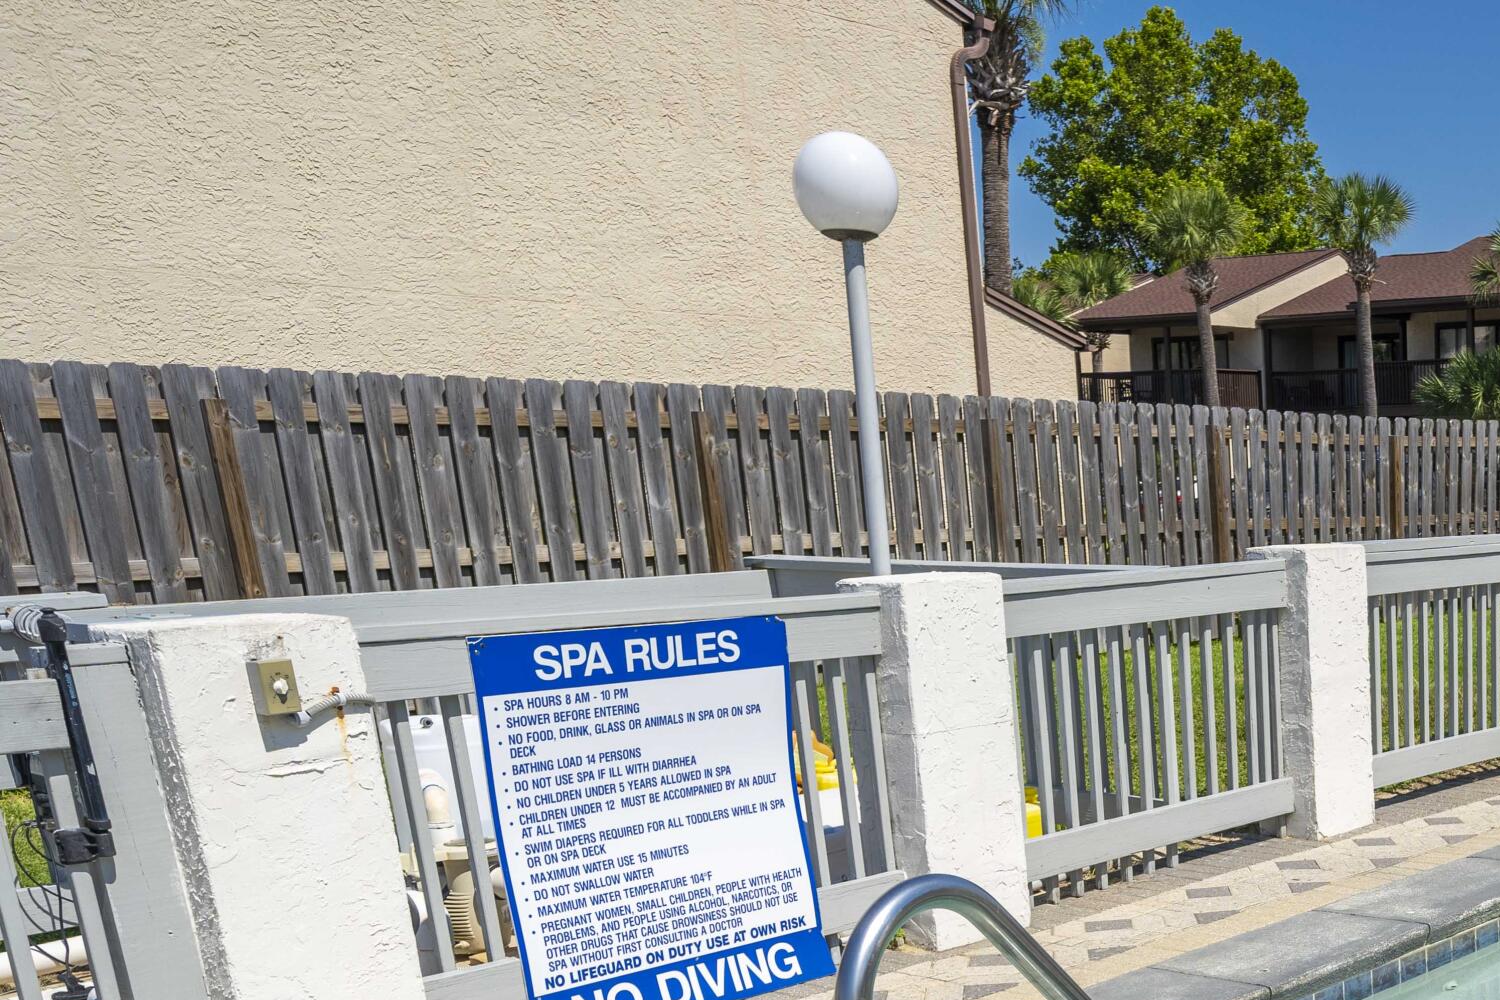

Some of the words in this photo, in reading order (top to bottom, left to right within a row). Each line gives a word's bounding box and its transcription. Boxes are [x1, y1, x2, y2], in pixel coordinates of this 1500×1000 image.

[533, 641, 613, 681] SPA
[624, 629, 741, 673] RULES
[503, 698, 525, 712] SPA
[526, 694, 563, 710] HOURS
[564, 693, 572, 706] 8
[574, 691, 591, 705] AM
[599, 689, 611, 702] 10
[613, 687, 629, 700] PM
[505, 712, 551, 729] SHOWER
[552, 708, 592, 724] BEFORE
[593, 702, 641, 719] ENTERING
[507, 732, 524, 746] NO
[525, 729, 557, 744] FOOD,
[558, 724, 592, 740] DRINK,
[594, 720, 626, 735] GLASS
[628, 718, 642, 731] OR
[644, 712, 685, 729] ANIMALS
[686, 711, 696, 723] IN
[697, 709, 715, 722] SPA
[716, 707, 730, 719] OR
[730, 705, 744, 717] ON
[745, 703, 762, 716] SPA
[509, 744, 537, 760] DECK
[511, 759, 555, 776] BATHING
[556, 755, 583, 770] LOAD
[584, 753, 597, 766] 14
[598, 746, 642, 764] PERSONS
[513, 779, 529, 793] DO
[531, 776, 552, 791] NOT
[554, 773, 575, 787] USE
[576, 770, 596, 784] SPA
[597, 768, 606, 781] IF
[608, 766, 624, 779] ILL
[624, 761, 650, 776] WITH
[651, 754, 697, 772] DIARRHEA
[515, 796, 532, 810] NO
[533, 788, 583, 807] CHILDREN
[584, 783, 617, 799] UNDER
[618, 781, 626, 793] 5
[626, 776, 658, 791] YEARS
[660, 769, 702, 786] ALLOWED
[703, 767, 714, 779] IN
[714, 764, 732, 778] SPA
[518, 807, 568, 826] CHILDREN
[569, 801, 603, 817] UNDER
[604, 799, 616, 811] 12
[620, 793, 647, 809] MUST
[648, 791, 661, 804] BE
[662, 781, 723, 802] ACCOMPANIED
[724, 779, 736, 791] BY
[738, 777, 750, 789] AN
[752, 772, 777, 787] ADULT
[521, 826, 533, 840] AT
[536, 823, 556, 837] ALL
[556, 817, 587, 833] TIMES
[523, 839, 554, 856] SWIM
[554, 832, 597, 850] DIAPERS
[598, 823, 645, 842] REQUIRED
[646, 819, 666, 833] FOR
[667, 816, 685, 830] ALL
[684, 808, 730, 826] TODDLERS
[730, 802, 758, 818] WHILE
[758, 801, 769, 812] IN
[769, 798, 786, 811] SPA
[526, 855, 542, 869] OR
[543, 852, 559, 866] ON
[560, 848, 580, 862] SPA
[581, 843, 607, 859] DECK
[529, 864, 581, 886] MAXIMUM
[582, 858, 616, 875] WATER
[616, 854, 636, 868] USE
[637, 852, 648, 864] 15
[649, 843, 690, 862] MINUTES
[533, 888, 549, 902] DO
[550, 883, 571, 898] NOT
[573, 873, 621, 894] SWALLOW
[622, 866, 655, 883] WATER
[536, 897, 588, 918] MAXIMUM
[588, 890, 622, 907] WATER
[622, 875, 689, 899] TEMPERATURE
[540, 912, 593, 934] PREGNANT
[594, 904, 635, 922] WOMEN,
[635, 896, 668, 913] SMALL
[668, 886, 714, 906] CHILDREN,
[715, 878, 748, 895] PEOPLE
[747, 874, 771, 888] WITH
[771, 867, 803, 883] HEALTH
[543, 924, 599, 947] PROBLEMS,
[601, 919, 621, 934] AND
[622, 911, 658, 929] PEOPLE
[658, 904, 687, 921] USING
[688, 896, 730, 914] ALCOHOL,
[731, 884, 780, 904] NARCOTICS,
[780, 881, 793, 893] OR
[545, 942, 579, 960] OTHER
[580, 934, 614, 952] DRUGS
[614, 928, 639, 944] THAT
[640, 921, 670, 938] CAUSE
[671, 907, 728, 931] DROWSINESS
[729, 900, 763, 917] SHOULD
[764, 895, 781, 909] NOT
[782, 891, 799, 905] USE
[544, 974, 566, 991] NO
[569, 955, 643, 984] LIFEGUARD
[645, 949, 665, 965] ON
[667, 940, 702, 960] DUTY
[705, 934, 731, 950] USE
[733, 929, 747, 944] AT
[749, 922, 778, 939] OWN
[779, 915, 807, 932] RISK
[548, 958, 568, 973] SPA
[569, 946, 614, 968] WITHOUT
[616, 940, 643, 956] FIRST
[644, 927, 699, 950] CONSULTING
[700, 925, 708, 936] A
[708, 916, 744, 934] DOCTOR
